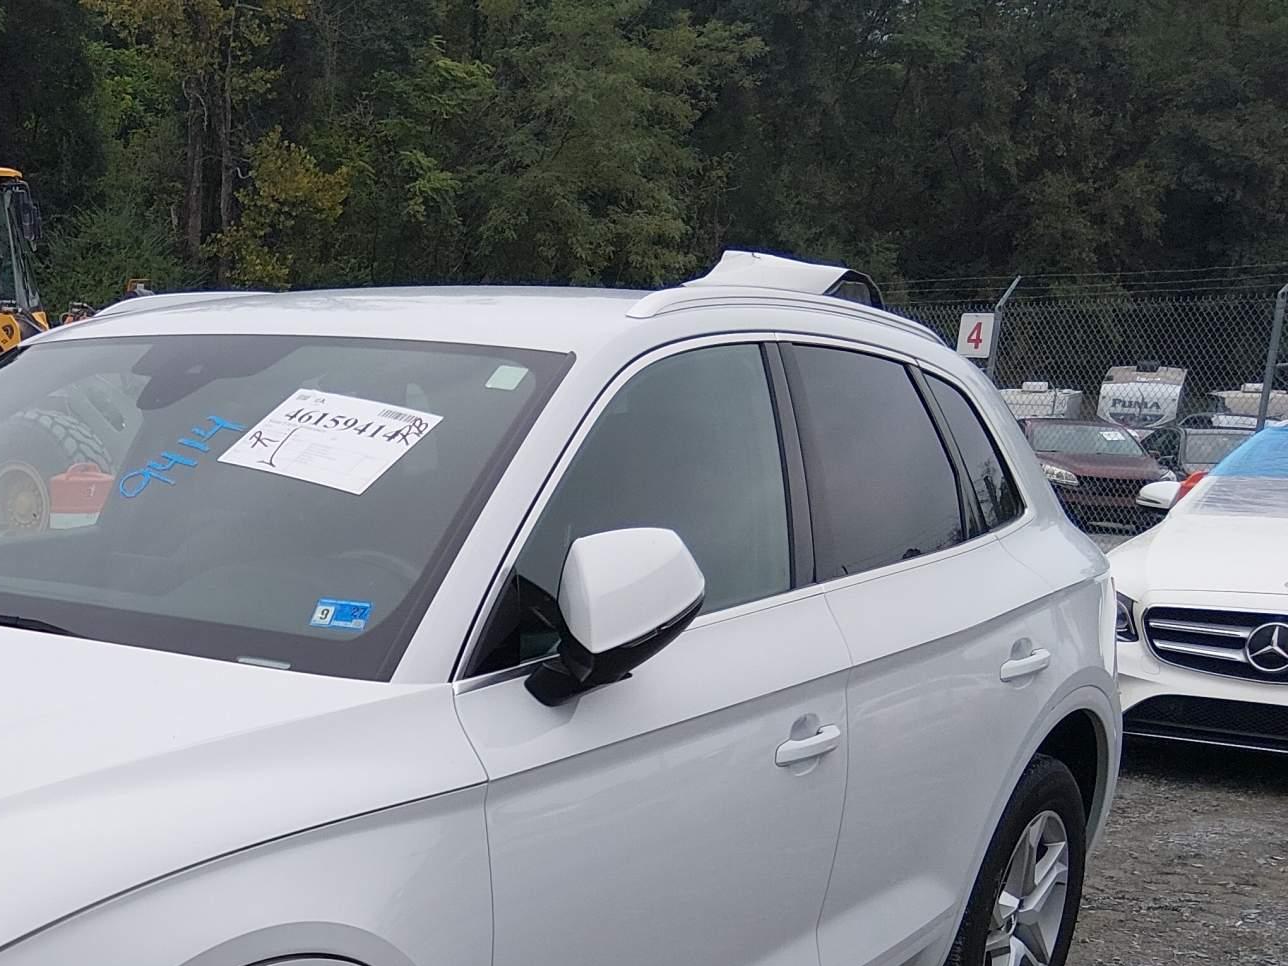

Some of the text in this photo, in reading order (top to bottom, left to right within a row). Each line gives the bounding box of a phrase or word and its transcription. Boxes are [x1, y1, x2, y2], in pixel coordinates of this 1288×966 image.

[967, 321, 983, 350] 4
[285, 408, 402, 442] 46159414
[119, 415, 247, 498] 9414
[319, 608, 330, 620] 9
